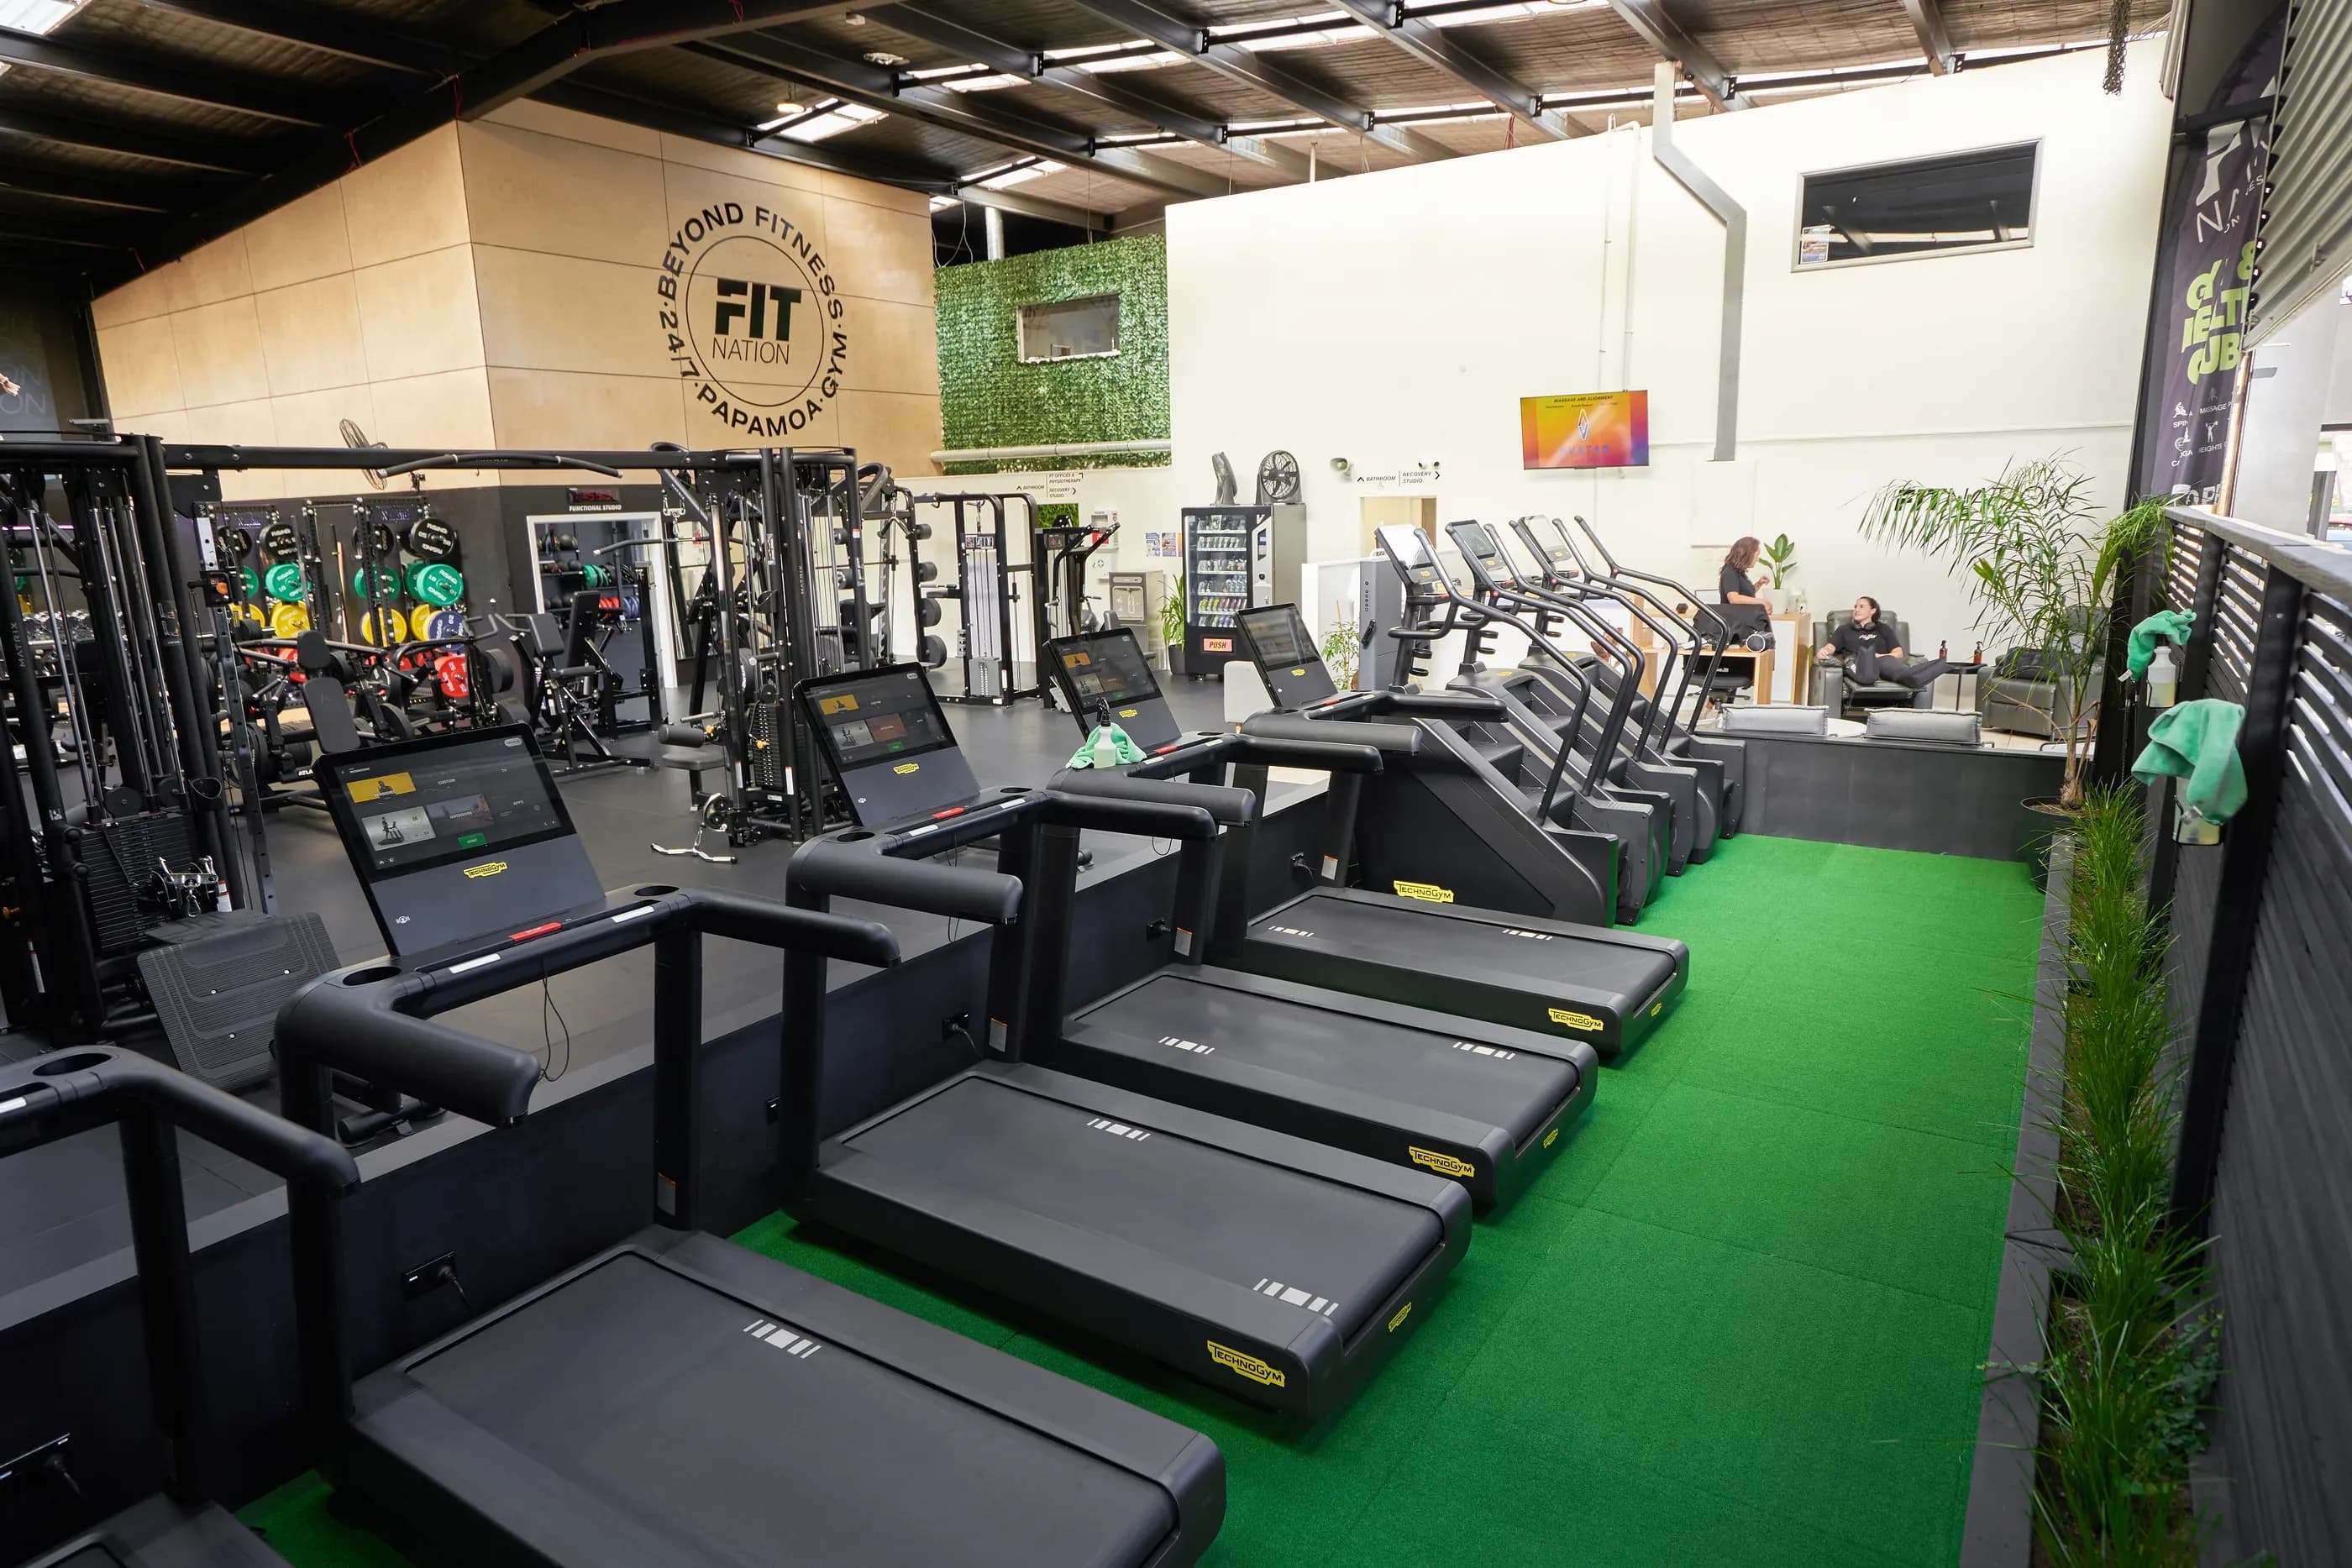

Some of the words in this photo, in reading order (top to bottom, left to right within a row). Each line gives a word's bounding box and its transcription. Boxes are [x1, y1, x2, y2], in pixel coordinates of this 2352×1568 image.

[658, 202, 743, 301] BEYOND
[755, 206, 843, 320] FITNESS
[715, 277, 801, 342] FIT
[712, 337, 790, 365] NATION
[696, 383, 822, 438] PAPAMOA
[821, 335, 848, 398] GYM
[11, 622, 27, 668] MATRIX
[1209, 641, 1227, 649] PUSH
[1395, 882, 1452, 900] TECHNOGYM
[1550, 1010, 1602, 1028] TECHNOGYM
[1410, 1147, 1473, 1174] TECHNOGYM
[1209, 1343, 1284, 1382] TECHNOGYM
